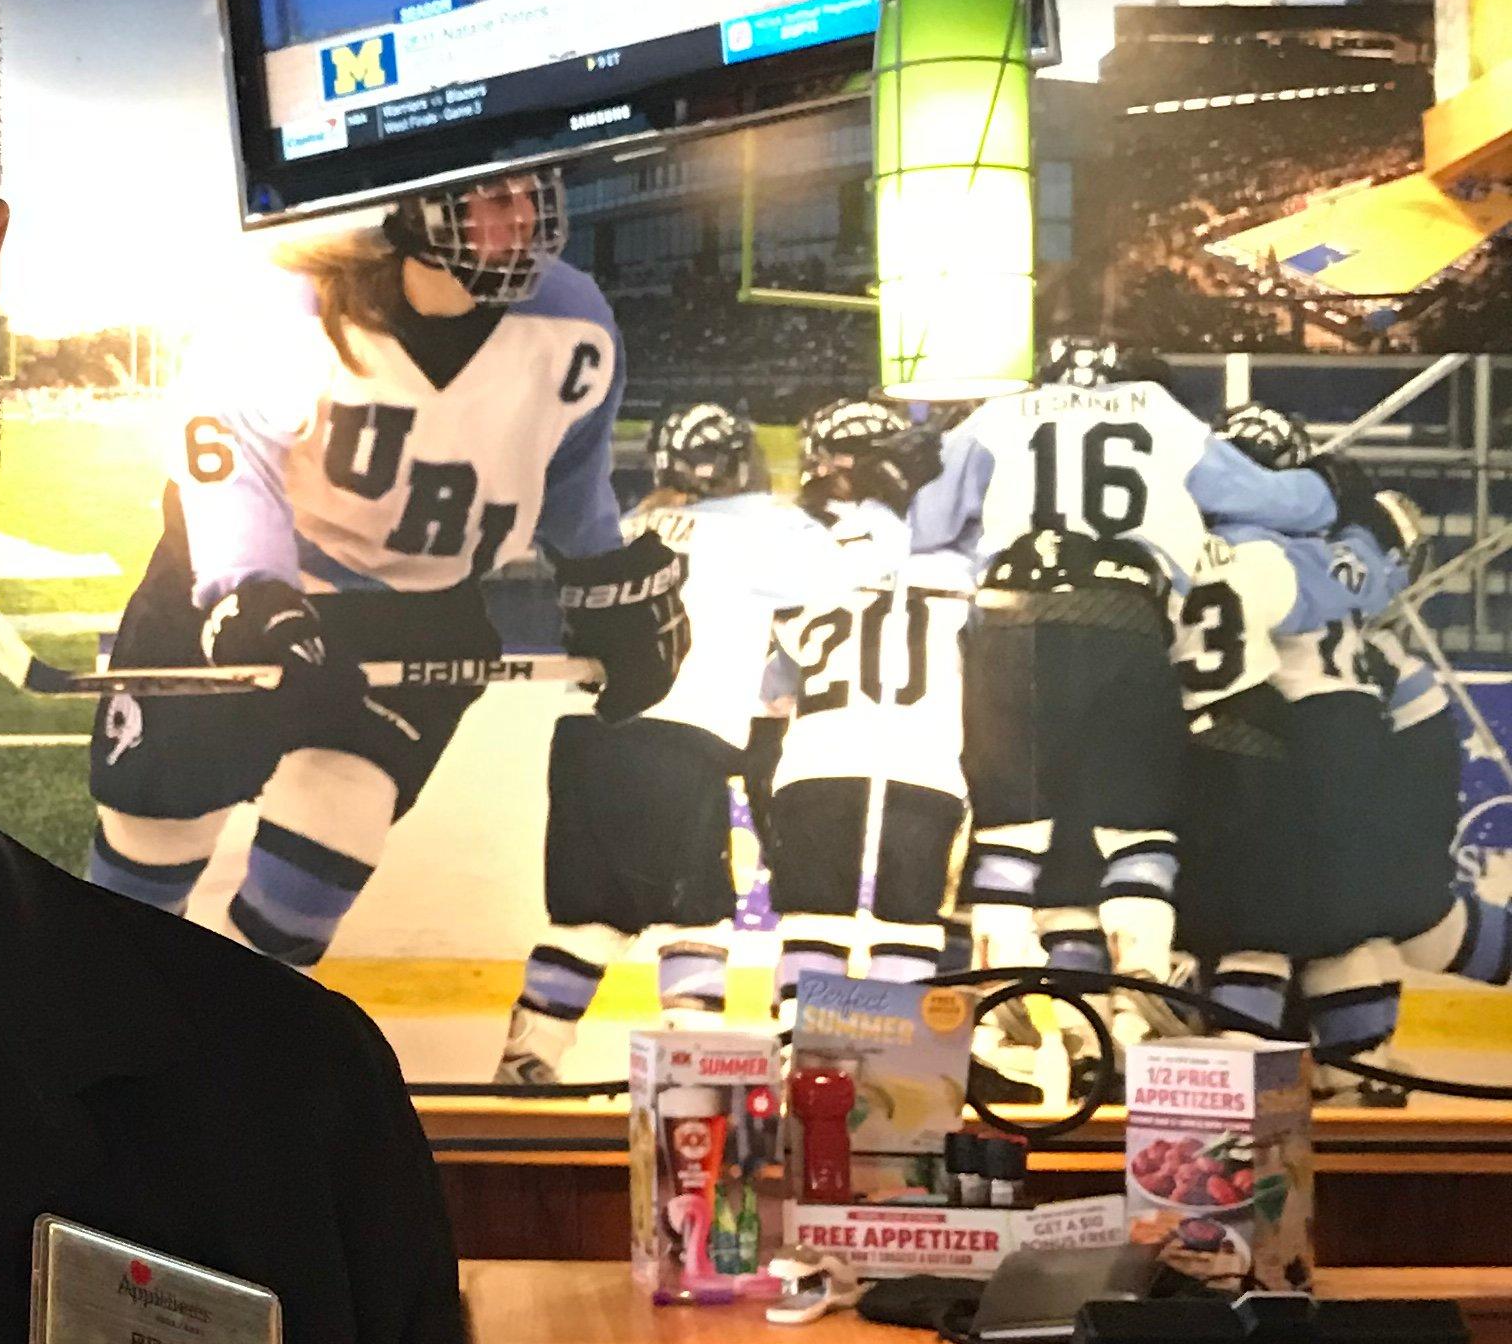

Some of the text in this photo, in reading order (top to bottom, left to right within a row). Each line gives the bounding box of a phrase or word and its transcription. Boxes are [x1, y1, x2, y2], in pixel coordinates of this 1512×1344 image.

[331, 37, 386, 96] M
[570, 105, 631, 130] SAMSUNG
[560, 341, 602, 404] C
[1029, 421, 1152, 536] 16
[699, 1058, 768, 1076] SUMMER
[1177, 1069, 1229, 1089] PRICE
[1135, 1087, 1245, 1112] APPETIZERS
[798, 1225, 1000, 1252] FREE APPETIZER
